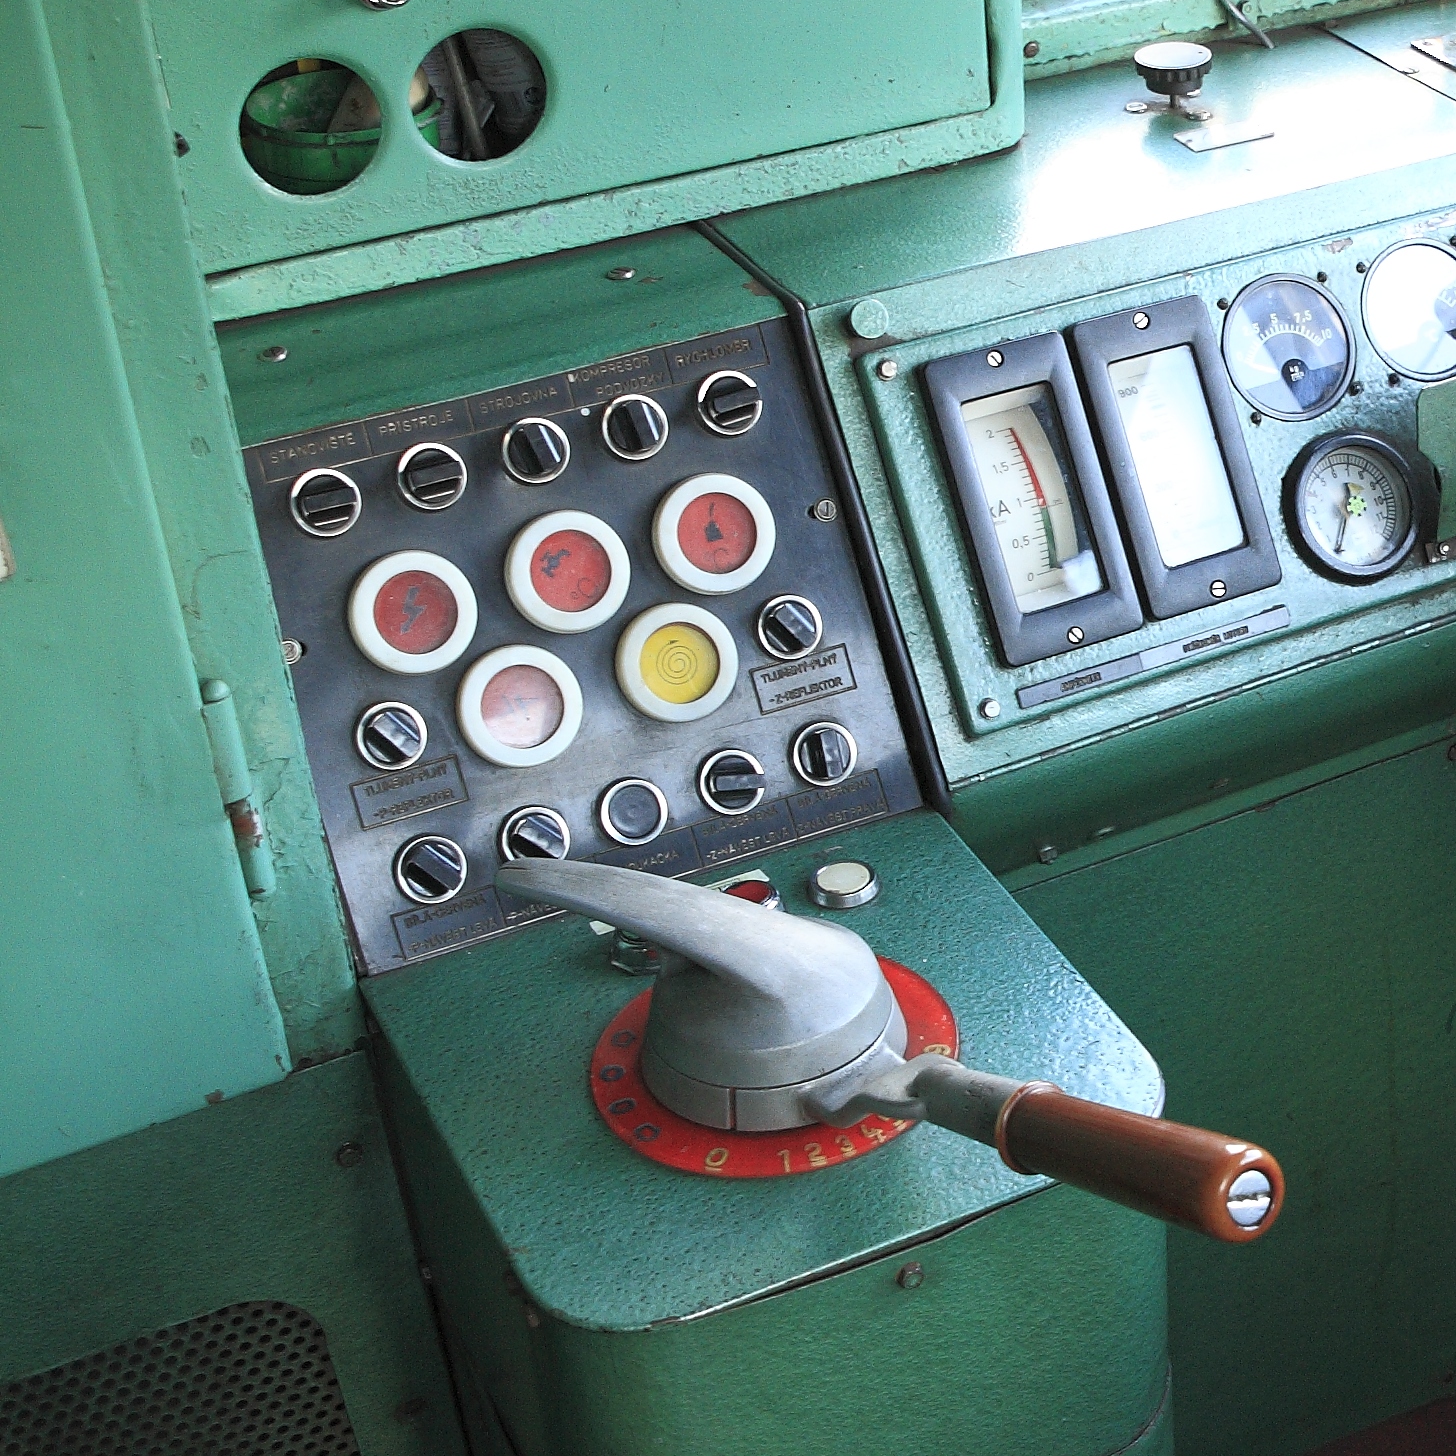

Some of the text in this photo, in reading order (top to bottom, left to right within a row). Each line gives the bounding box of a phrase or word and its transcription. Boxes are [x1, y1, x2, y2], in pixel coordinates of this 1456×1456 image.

[1269, 309, 1332, 341] 5 7,5 10
[573, 355, 650, 382] KOMPRESOR
[596, 372, 665, 396] PODVOZKY
[1117, 386, 1139, 399] 900
[479, 387, 558, 414] STROJOVNA
[986, 429, 995, 439] 2
[993, 461, 1010, 475] 1,5
[1017, 498, 1023, 508] 1
[1374, 495, 1384, 507] 10
[1012, 536, 1030, 549] 0,5
[1027, 572, 1034, 582] 0
[860, 1123, 886, 1144] 4
[804, 1142, 828, 1167] 2
[834, 1133, 857, 1157] 3
[704, 1146, 729, 1171] 0
[778, 1149, 791, 1173] 1
